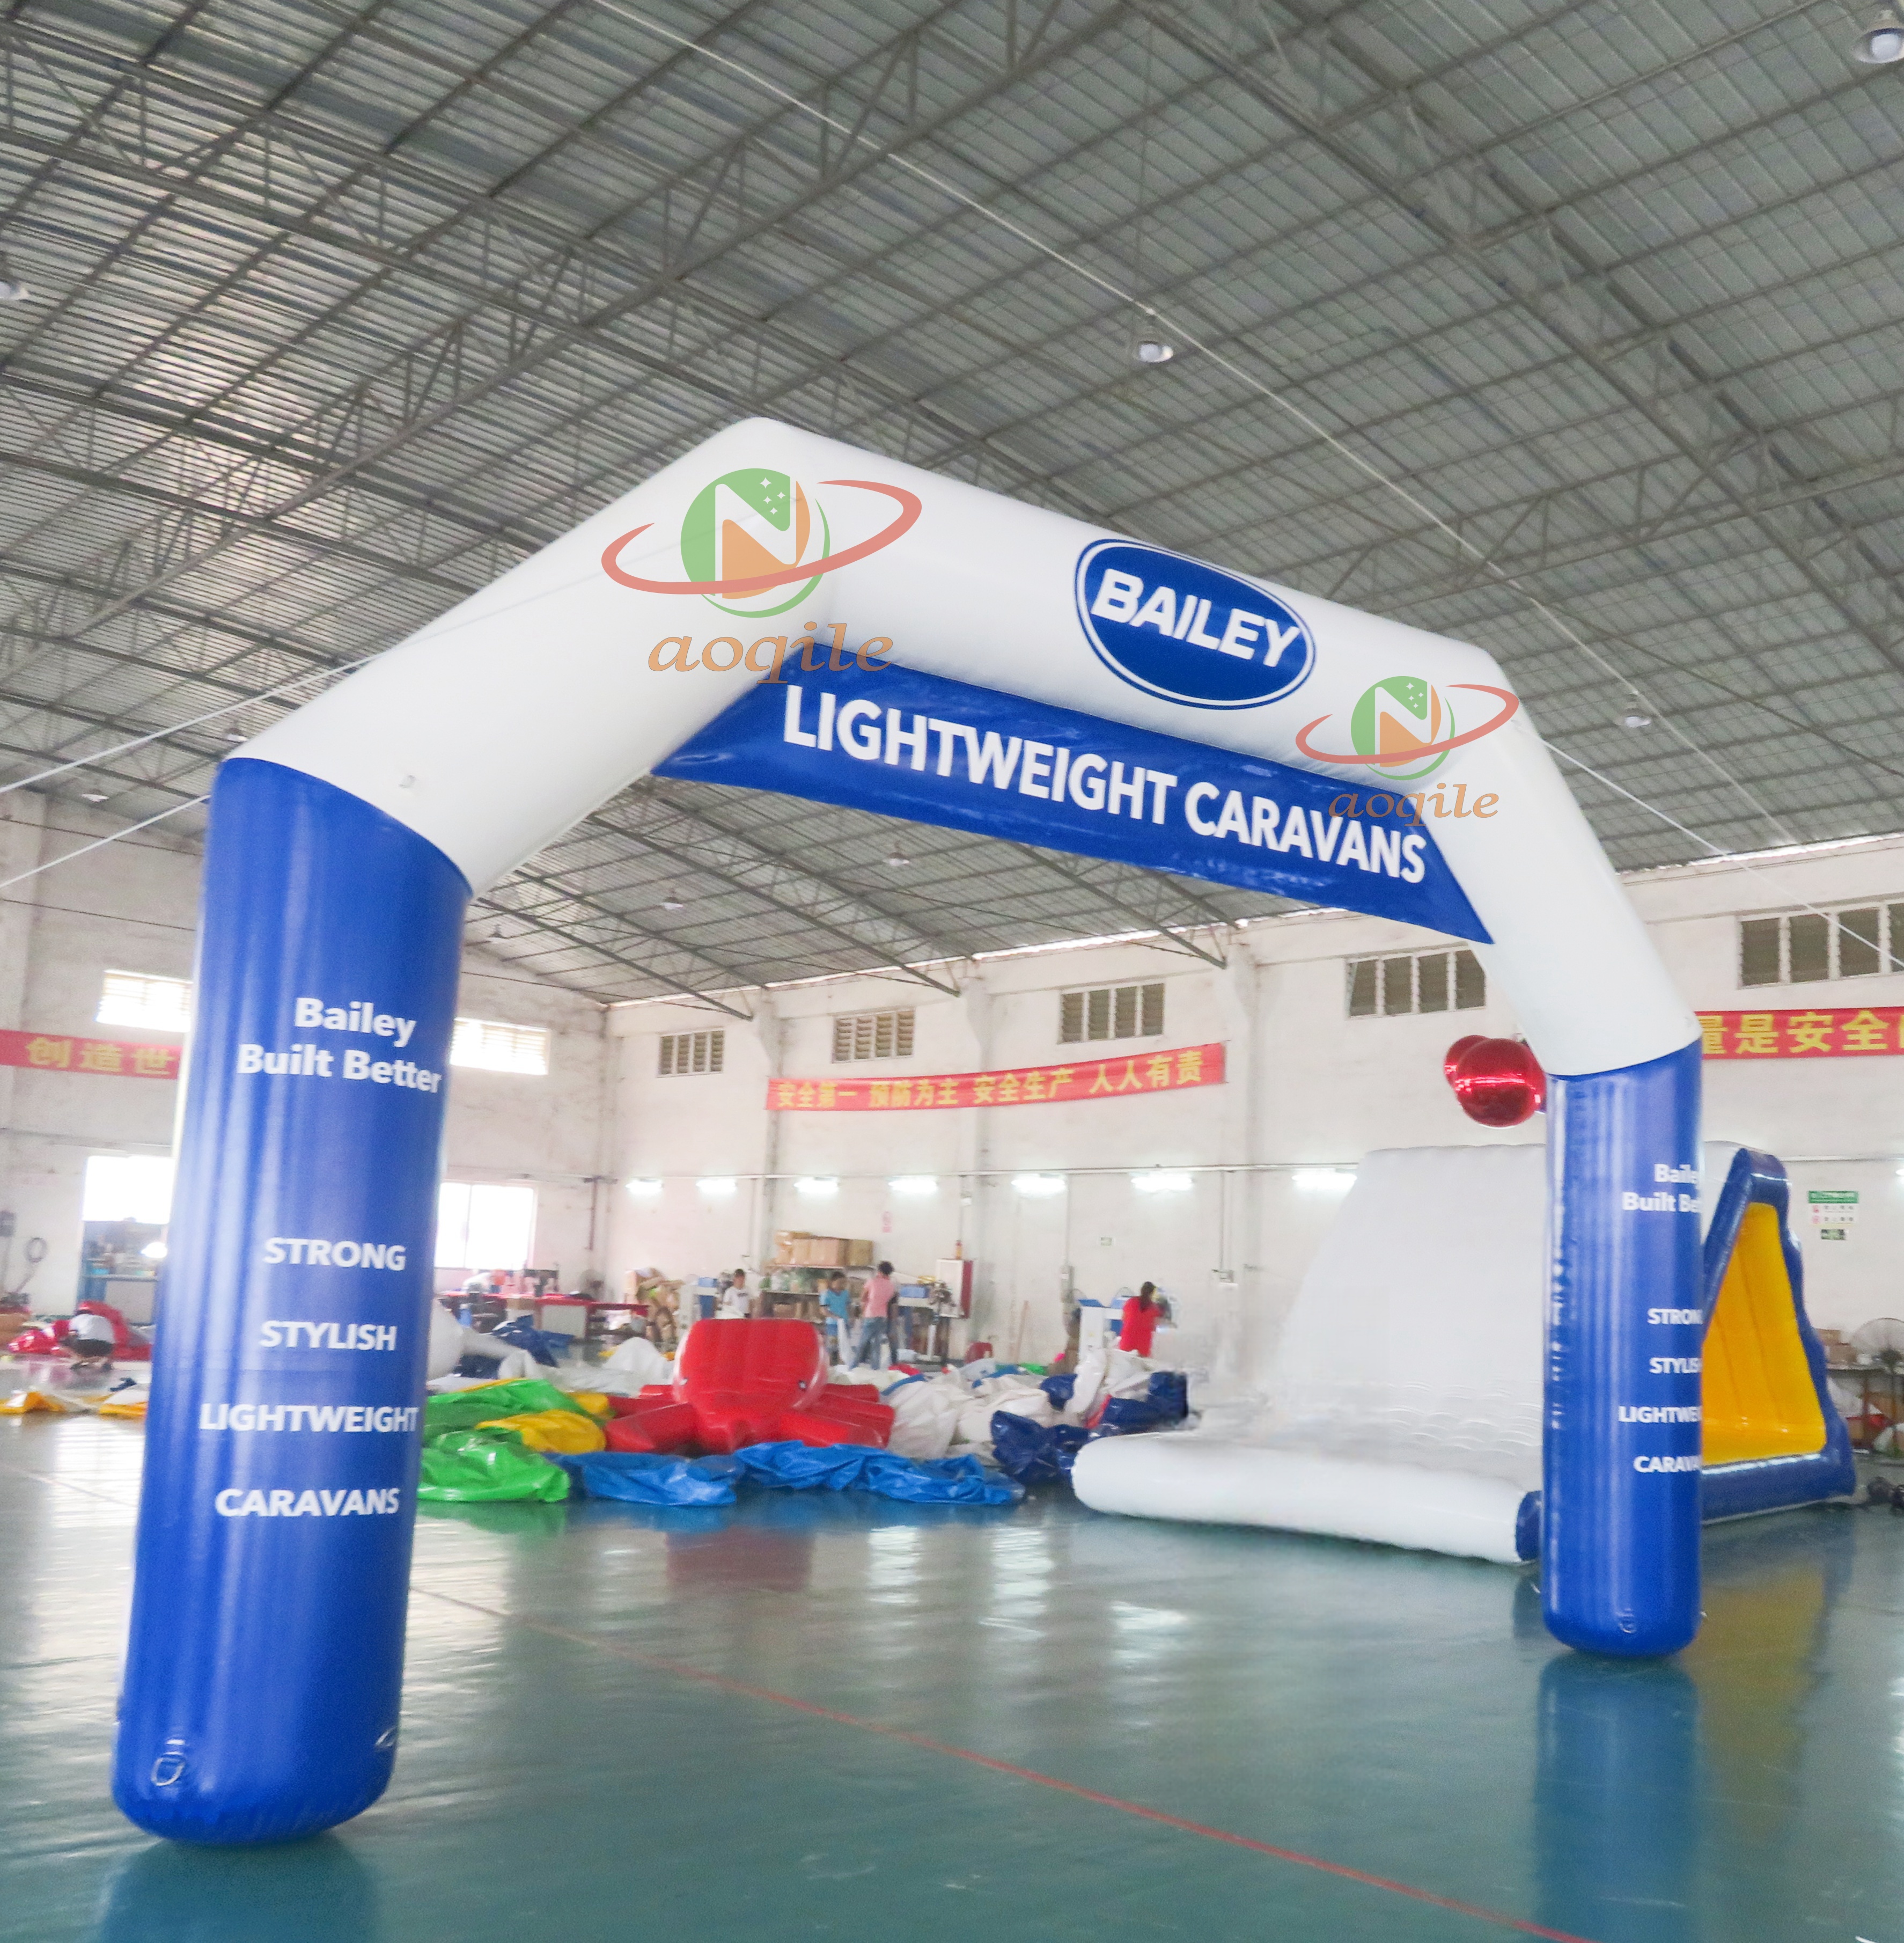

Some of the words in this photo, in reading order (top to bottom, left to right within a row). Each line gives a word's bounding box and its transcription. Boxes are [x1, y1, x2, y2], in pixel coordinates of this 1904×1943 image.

[1091, 568, 1300, 667] BAILEY
[784, 685, 1177, 825] LIGHTWEIGHT
[1185, 782, 1426, 883] CARAVANS
[295, 998, 416, 1047] Bailey
[1697, 1009, 1904, 1054] 量是安全
[238, 1044, 334, 1077] Built
[343, 1050, 442, 1093] Better
[973, 1068, 1075, 1104] 安全生产
[1089, 1050, 1203, 1095] 人人有责
[1622, 1192, 1676, 1212] Built
[262, 1237, 406, 1271] STRONG
[259, 1321, 397, 1351] STYLISH
[200, 1403, 419, 1432] LIGHTWEIGHT
[215, 1488, 400, 1516] CARAVANS
